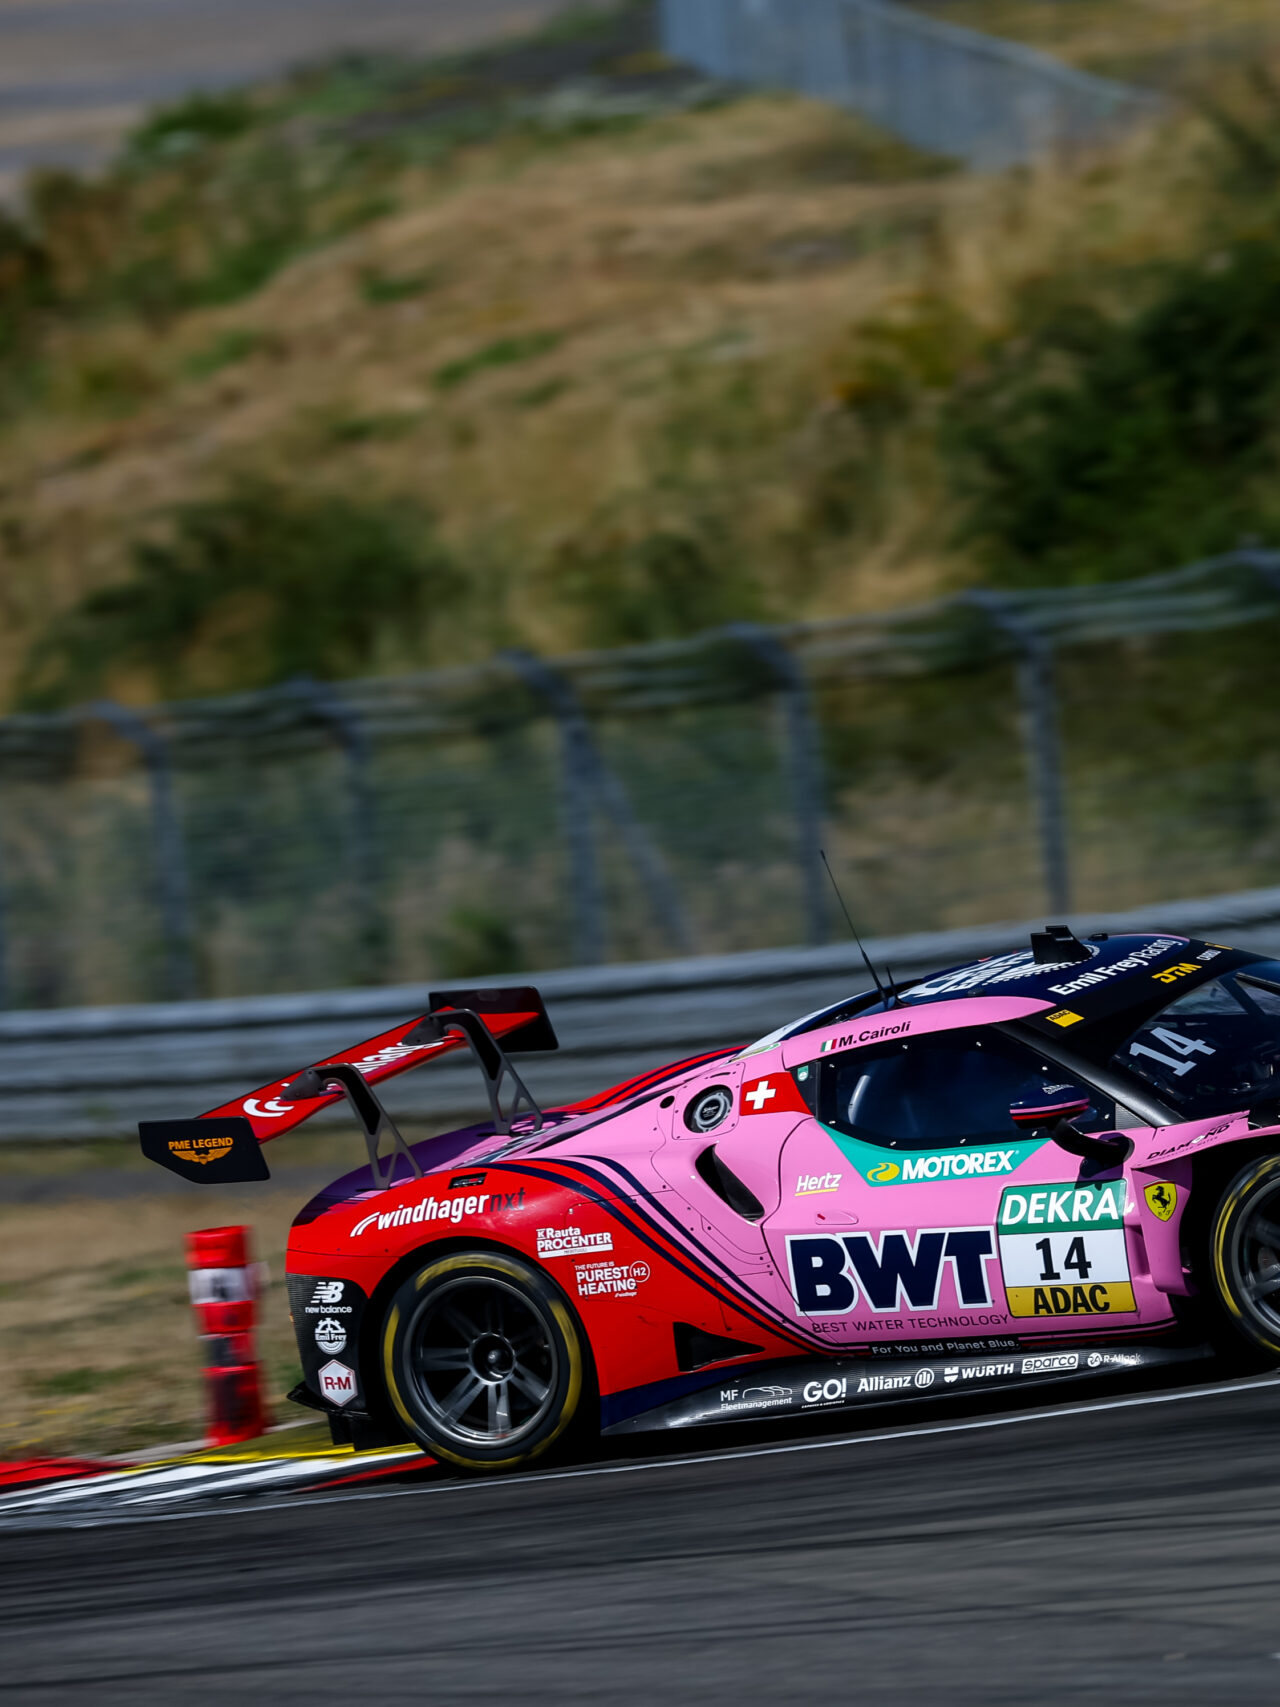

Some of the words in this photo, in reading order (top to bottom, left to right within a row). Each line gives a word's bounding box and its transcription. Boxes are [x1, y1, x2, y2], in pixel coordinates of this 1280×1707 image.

[1048, 972, 1106, 995] Emil
[1093, 955, 1150, 978] Frey
[1128, 938, 1183, 963] Racing
[1152, 962, 1202, 984] DTM
[838, 1021, 911, 1049] M.Cairoli
[1129, 1026, 1216, 1076] 14
[168, 1140, 191, 1151] PME
[192, 1136, 234, 1149] LEGEND
[902, 1150, 1015, 1181] MOTOREX
[796, 1172, 842, 1192] Hertz
[377, 1194, 490, 1231] windhager
[1002, 1187, 1119, 1225] DEKRA
[537, 1232, 612, 1252] PROCENTER
[586, 1262, 608, 1270] FUTURE
[1035, 1236, 1092, 1281] 14
[576, 1266, 629, 1283] PUREST
[633, 1266, 647, 1276] H2
[785, 1226, 997, 1316] BWT
[577, 1278, 636, 1296] HEATING
[305, 1305, 320, 1314] new
[320, 1305, 352, 1314] balance
[1034, 1285, 1111, 1315] ADAC
[812, 1321, 848, 1334] BEST
[853, 1319, 904, 1332] WATER
[908, 1314, 1009, 1329] TECHNOLOGY
[872, 1346, 892, 1355] For
[895, 1344, 918, 1354] You
[921, 1342, 944, 1352] and
[946, 1340, 984, 1350] Planet
[988, 1338, 1019, 1348] Blue.
[1023, 1355, 1077, 1373] sparco
[324, 1376, 351, 1391] R-M
[803, 1377, 847, 1403] GO!
[857, 1375, 911, 1393] Allianz
[720, 1389, 739, 1402] MF
[720, 1397, 792, 1411] Fleetmanagement
